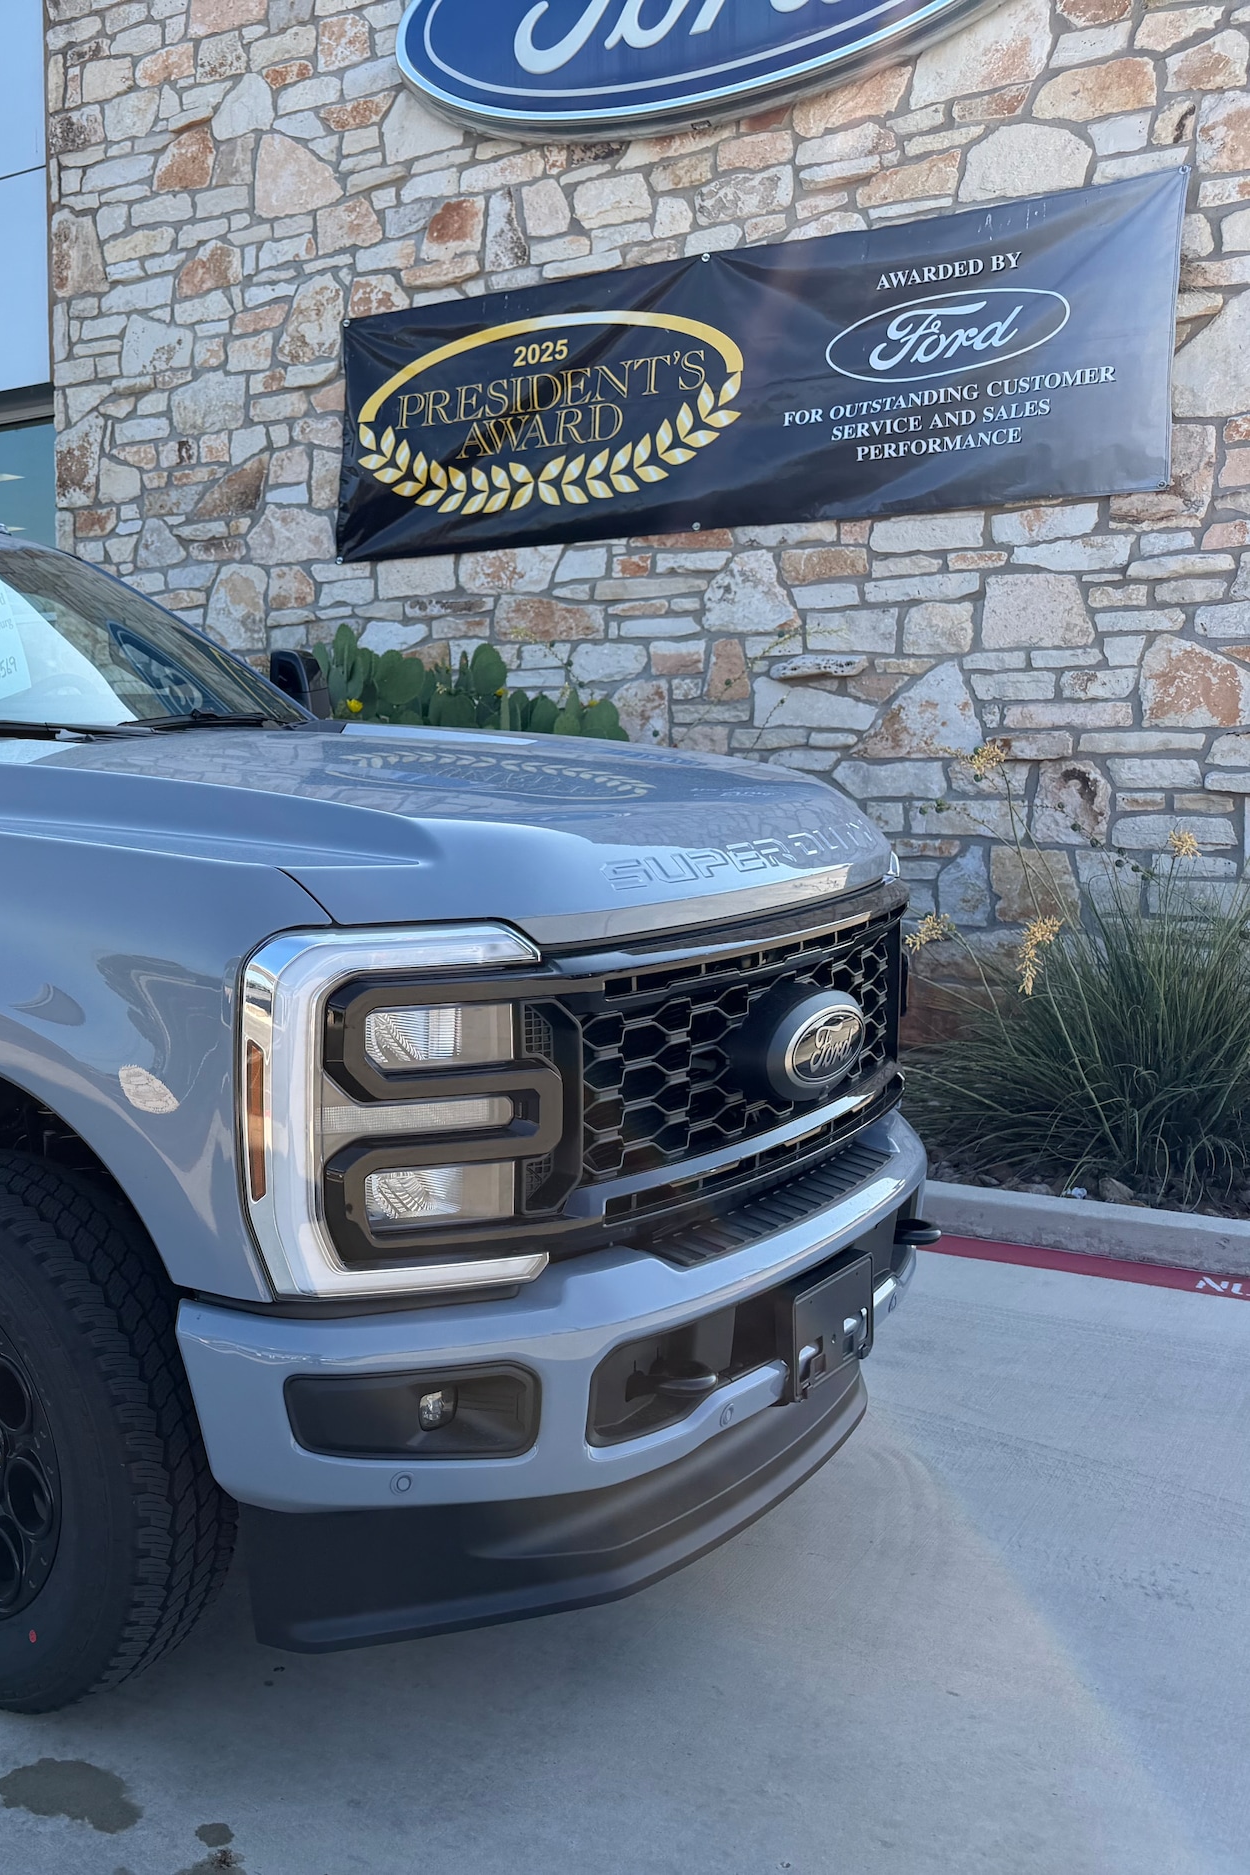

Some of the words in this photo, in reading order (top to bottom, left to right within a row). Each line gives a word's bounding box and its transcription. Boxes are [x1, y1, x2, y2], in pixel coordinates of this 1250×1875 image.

[876, 258, 984, 291] AWARDED
[990, 251, 1023, 273] BY
[513, 339, 568, 368] 2025
[868, 300, 1024, 371] Ford
[395, 350, 707, 430] PRESIDENT'S
[782, 410, 824, 428] FOR
[829, 383, 980, 421] OUTSTANDING
[986, 365, 1117, 399] CUSTOMER
[454, 402, 625, 460] AWARD
[831, 415, 923, 442] SERVICE
[929, 409, 977, 431] AND
[982, 398, 1051, 424] SALES
[856, 427, 1023, 462] PERFORMANCE
[601, 838, 797, 891] SUPER
[810, 1022, 854, 1074] Ford
